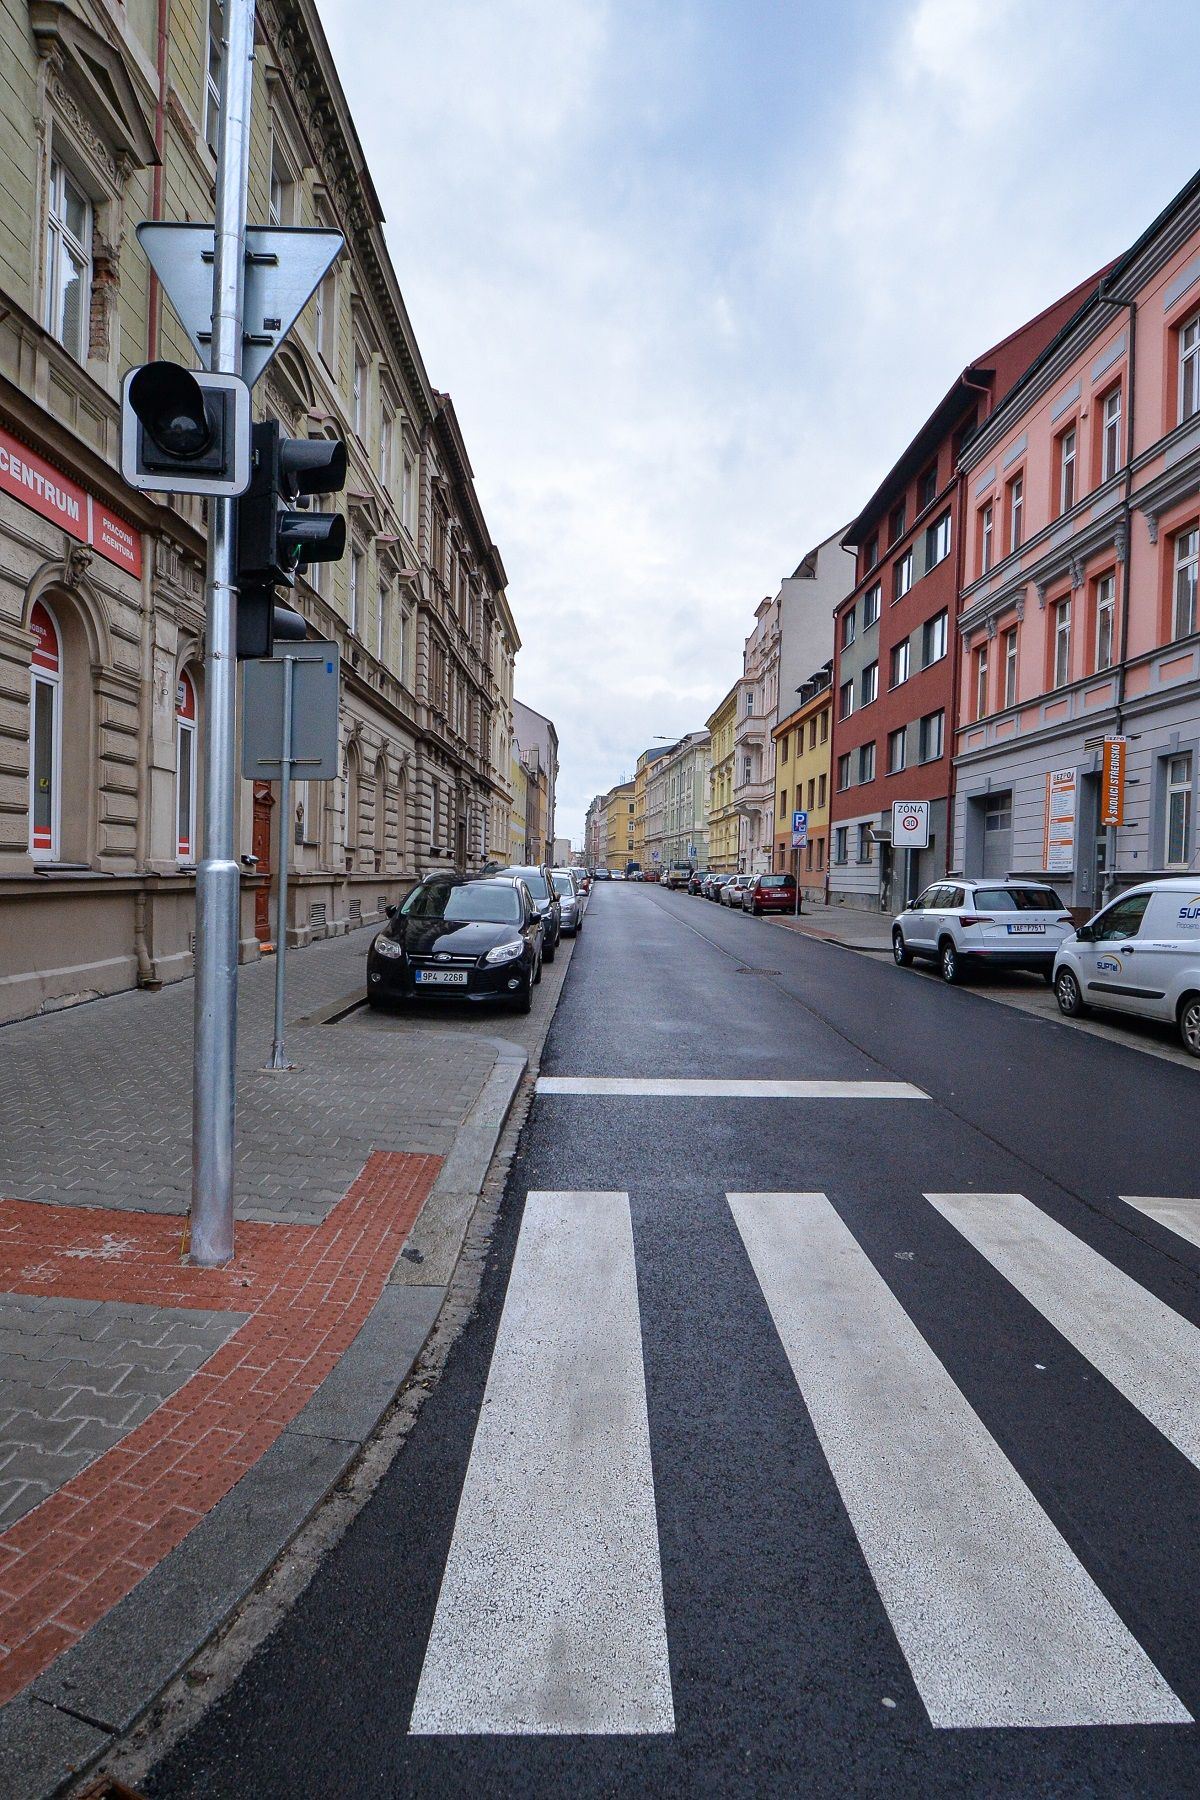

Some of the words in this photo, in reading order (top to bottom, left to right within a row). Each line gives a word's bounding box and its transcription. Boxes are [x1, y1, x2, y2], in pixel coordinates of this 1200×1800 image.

[0, 447, 79, 522] CENTRUM
[103, 517, 133, 546] PRACOVNÍ
[101, 532, 135, 562] AGENTURA
[1109, 744, 1120, 784] STŘEDISKO
[898, 804, 924, 814] ZÓNA
[795, 814, 805, 827] P
[905, 819, 915, 827] 30
[423, 972, 438, 981] 9P4
[443, 973, 464, 982] 2268
